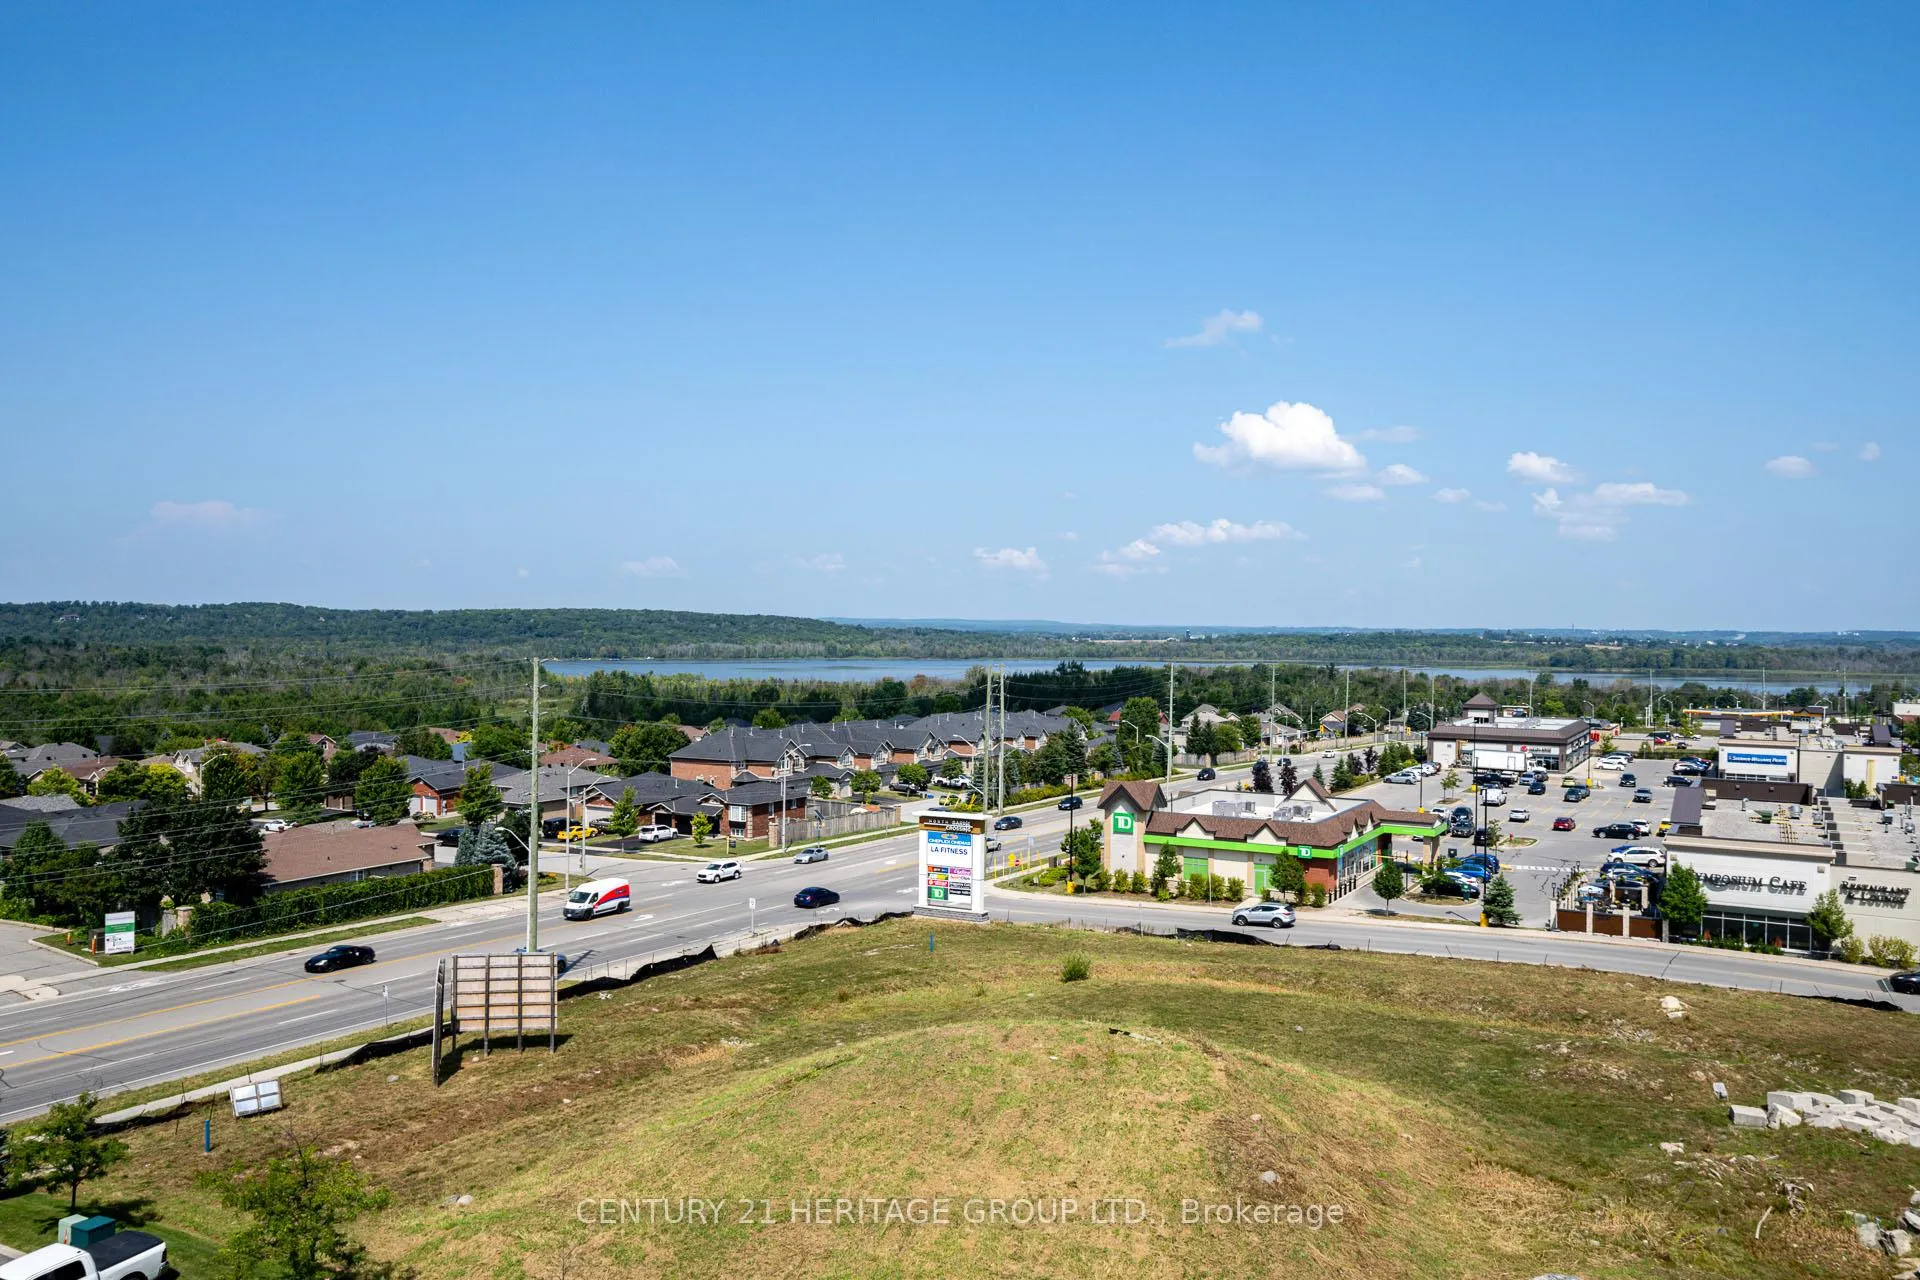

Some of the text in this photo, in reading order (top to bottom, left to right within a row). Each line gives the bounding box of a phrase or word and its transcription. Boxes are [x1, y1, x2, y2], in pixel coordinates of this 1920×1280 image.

[1114, 815, 1132, 829] TD
[940, 847, 968, 855] FITNESS
[1299, 847, 1311, 857] TD
[1692, 872, 1763, 887] YMPOSIUM
